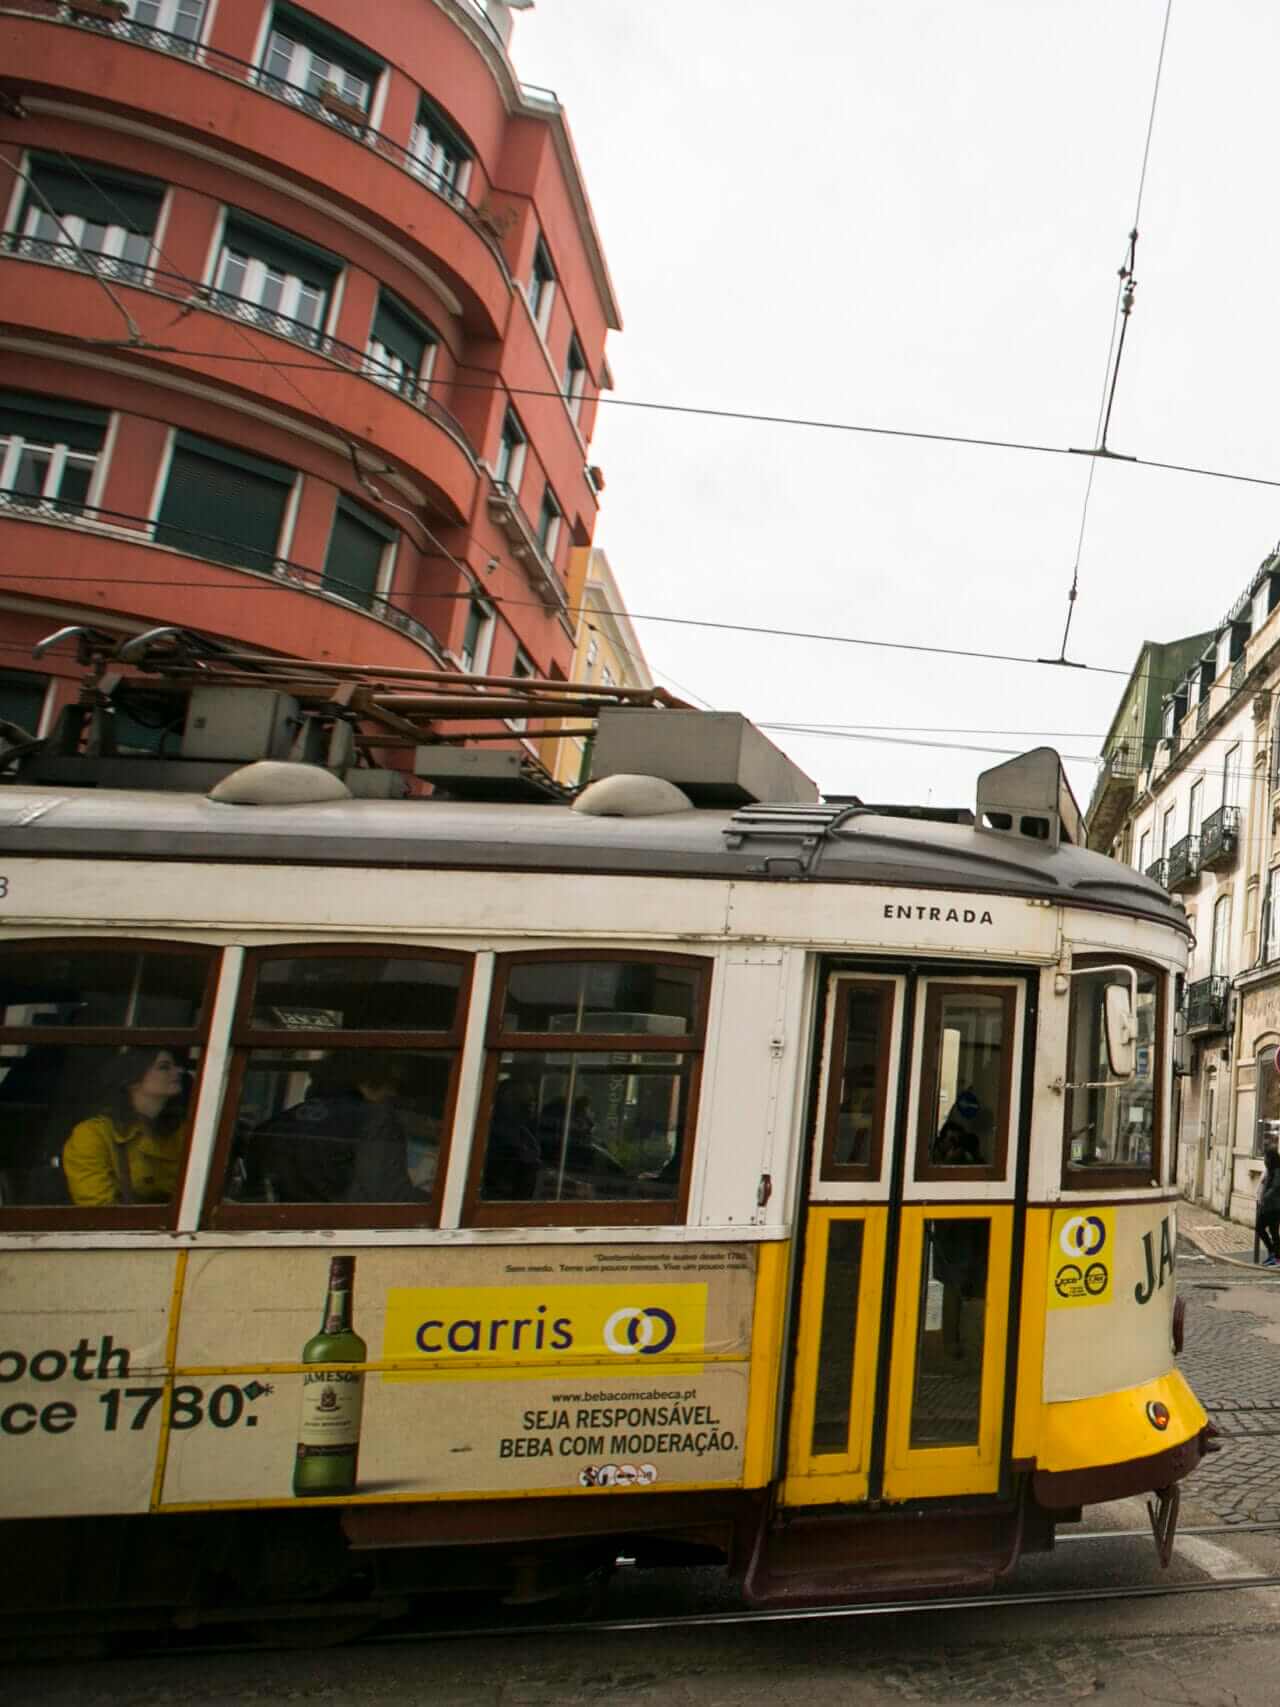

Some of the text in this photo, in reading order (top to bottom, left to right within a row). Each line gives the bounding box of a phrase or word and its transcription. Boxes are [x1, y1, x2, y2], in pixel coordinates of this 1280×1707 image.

[883, 904, 993, 925] ENTRADA
[415, 1305, 573, 1352] carris
[551, 1389, 697, 1403] www.bebacomcabeca.pt
[522, 1402, 721, 1430] SEJA RESPONSÁVEL.
[499, 1428, 739, 1458] BEBA COM MODERAÇÃO.
